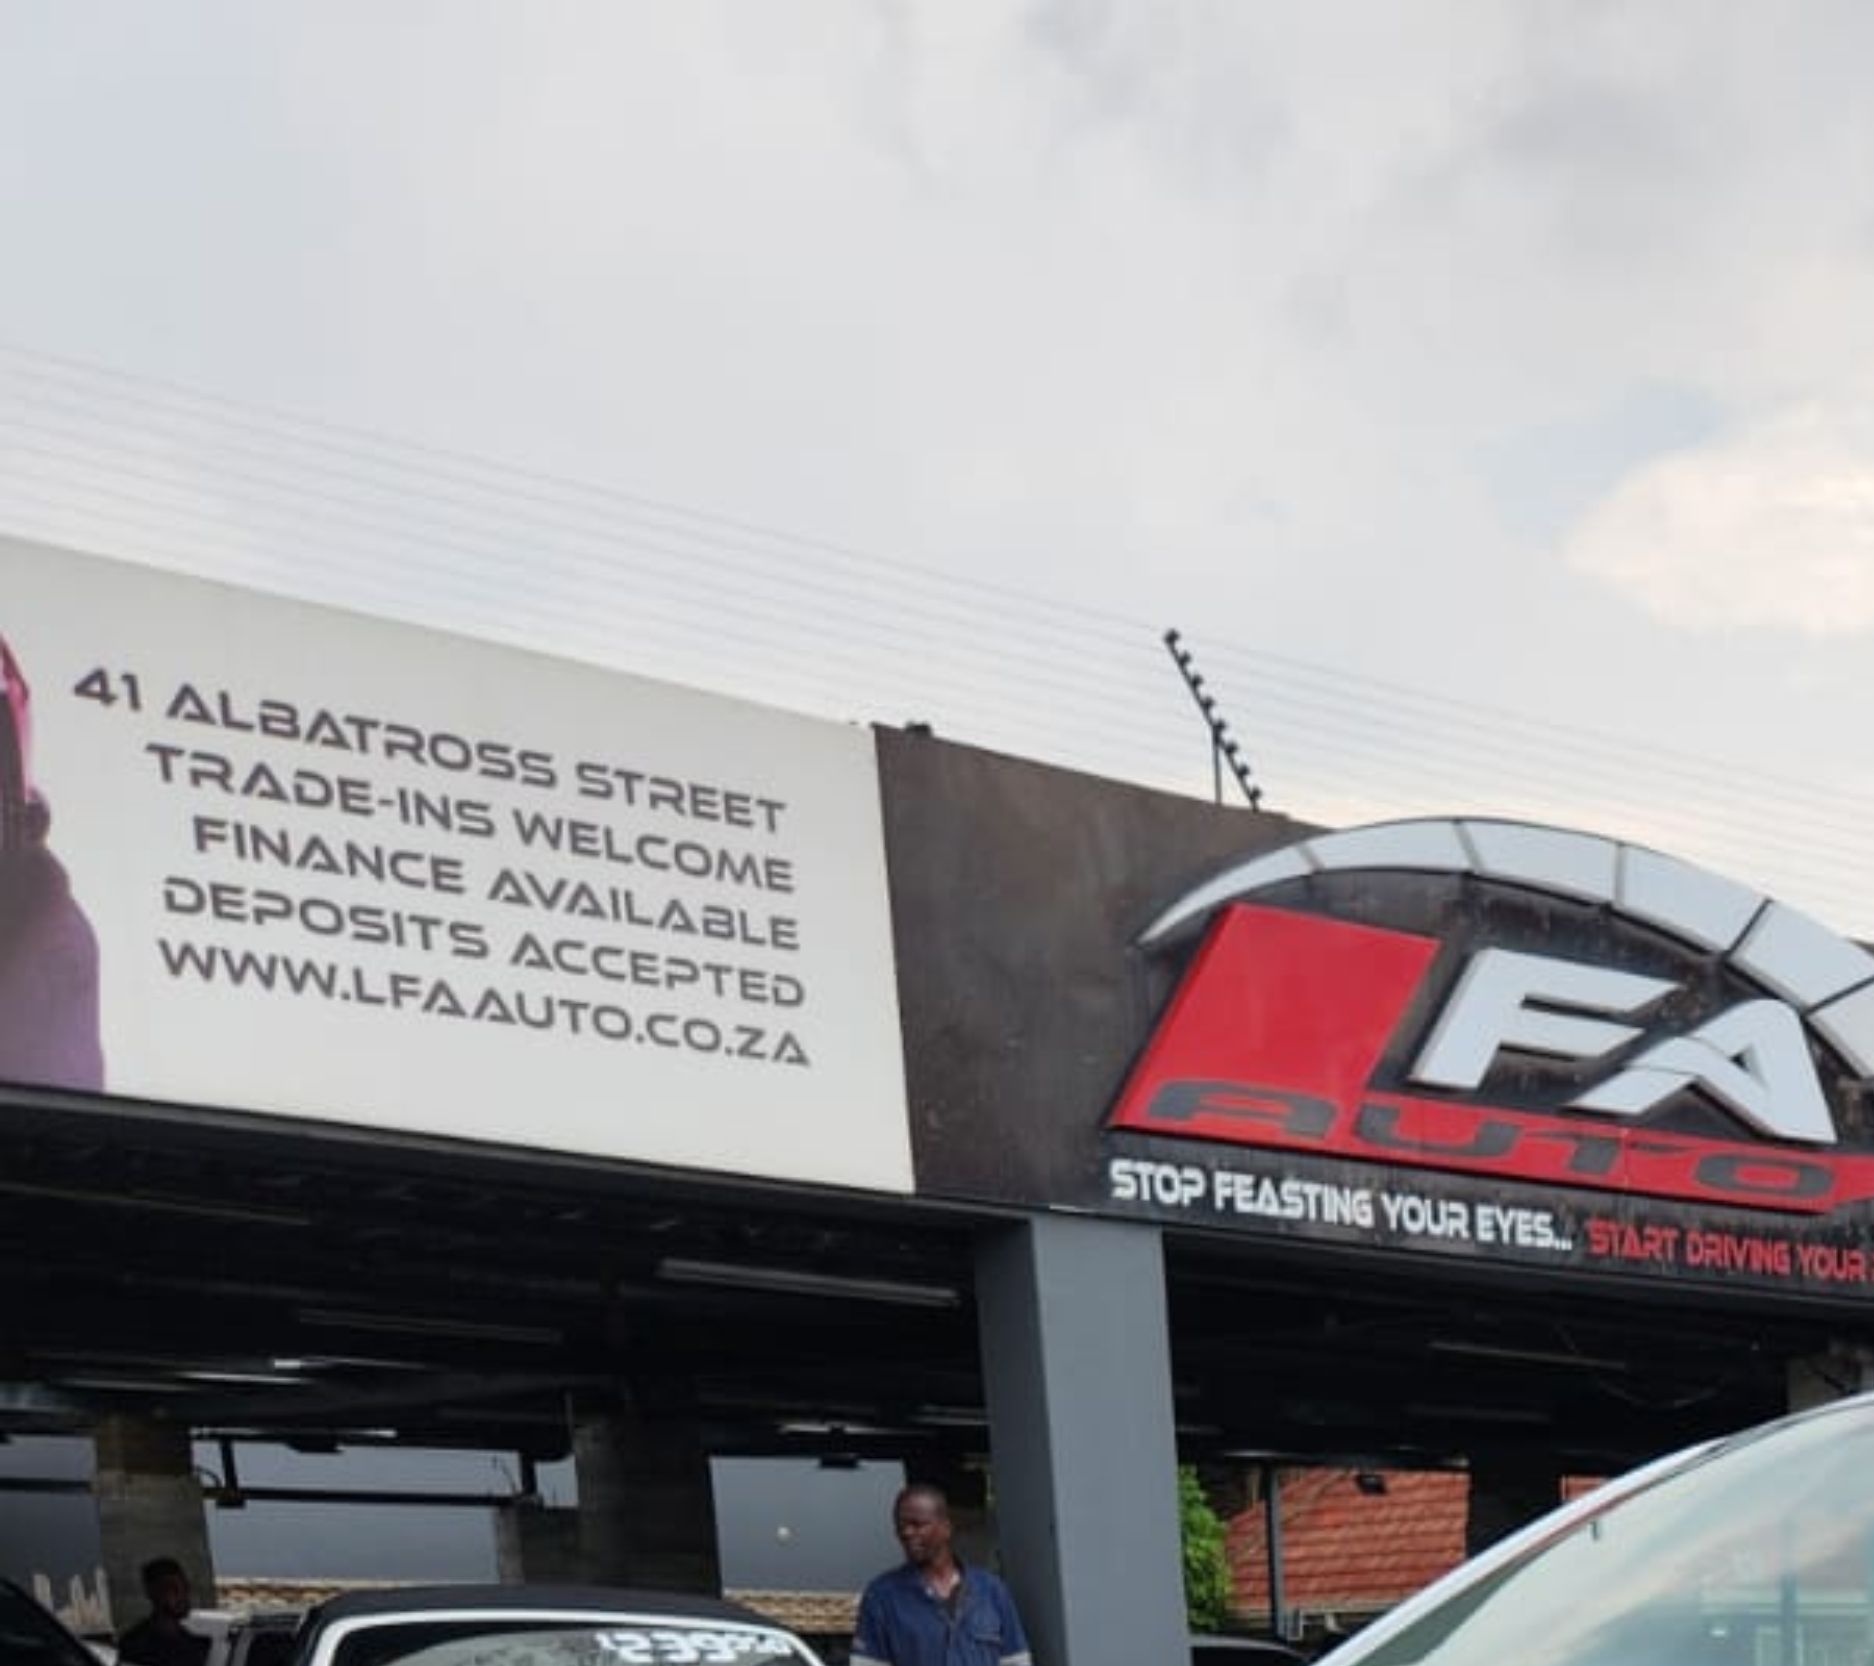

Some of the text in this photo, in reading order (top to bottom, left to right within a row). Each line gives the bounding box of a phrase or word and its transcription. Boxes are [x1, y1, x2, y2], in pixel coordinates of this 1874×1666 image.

[73, 667, 786, 833] 41 ALBATROSS STREET
[146, 743, 795, 893] TRADE-INS WELCOME
[193, 815, 800, 951] FINANCE AVAILABLE
[158, 938, 810, 1066] WWW.LFAAUTO.CO.ZA
[164, 875, 805, 1007] DEPOSITS ACCEPTED
[1143, 1080, 1838, 1202] AUTO
[1109, 1158, 1206, 1207] STOP
[1214, 1170, 1374, 1228] FEASTING
[1380, 1192, 1470, 1239] YOUR
[1476, 1204, 1574, 1251] EYES...
[1586, 1218, 1679, 1262] START
[1685, 1232, 1791, 1277] DRIVING
[1798, 1243, 1868, 1282] YOUR
